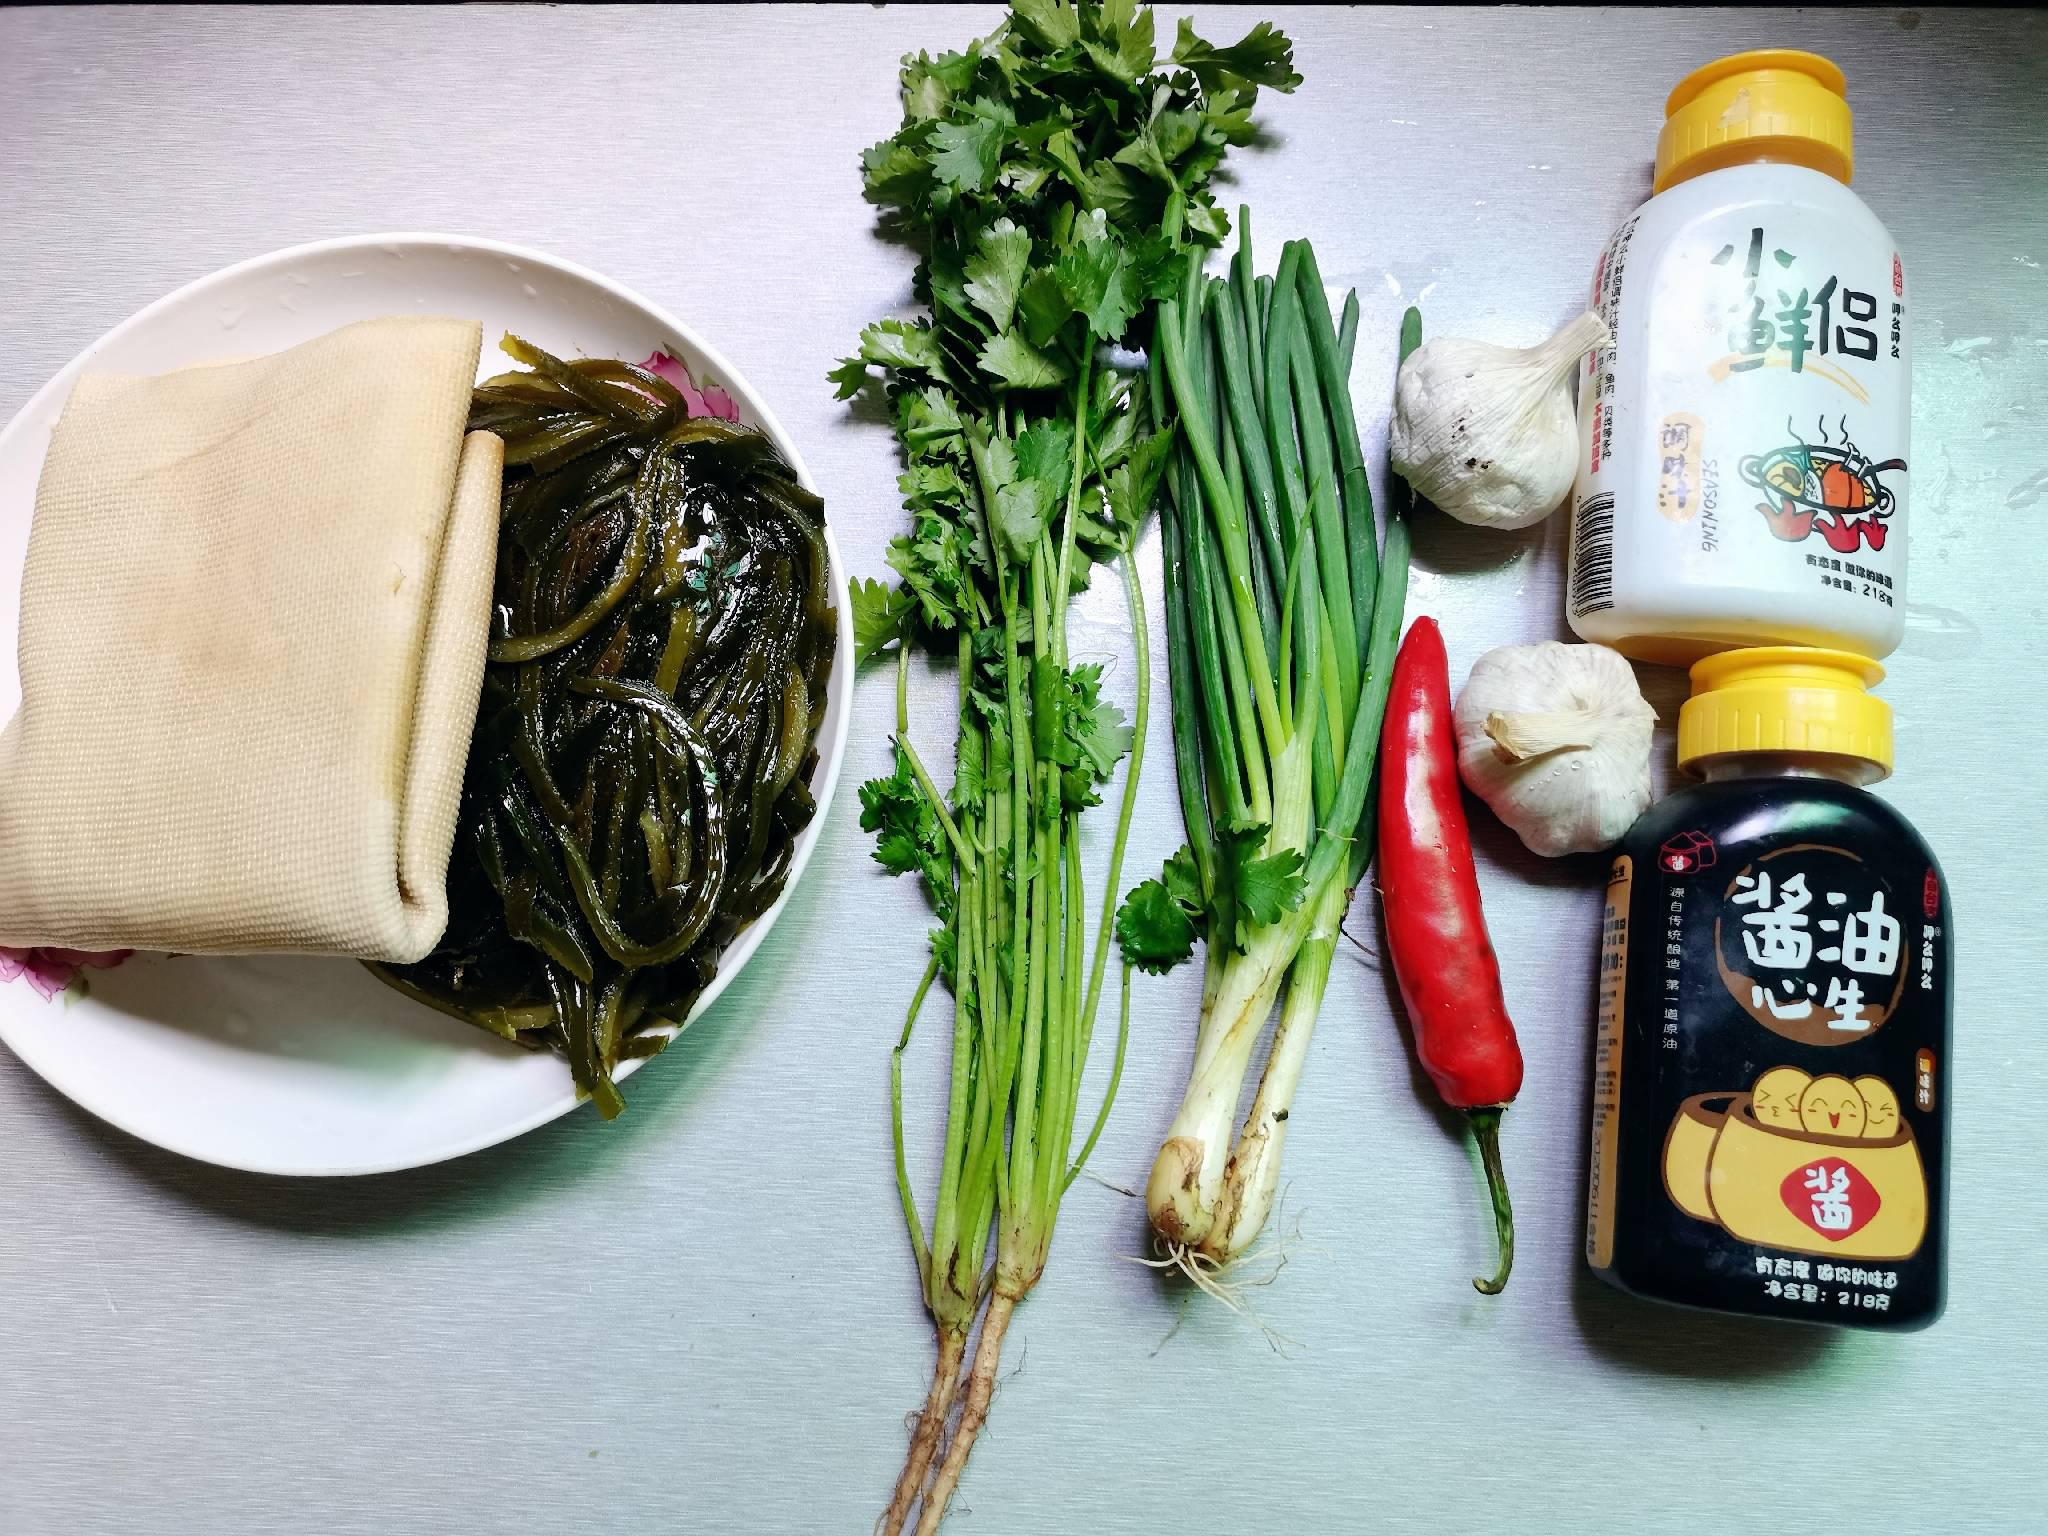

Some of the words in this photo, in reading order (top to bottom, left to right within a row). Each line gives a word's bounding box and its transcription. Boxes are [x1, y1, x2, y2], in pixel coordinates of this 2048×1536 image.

[1702, 459, 1719, 552] SEASONING
[1732, 871, 1900, 976] 酱油
[1662, 979, 1681, 1050] 第一道原油
[1752, 977, 1870, 1031] 心生
[1804, 1165, 1852, 1231] 酱
